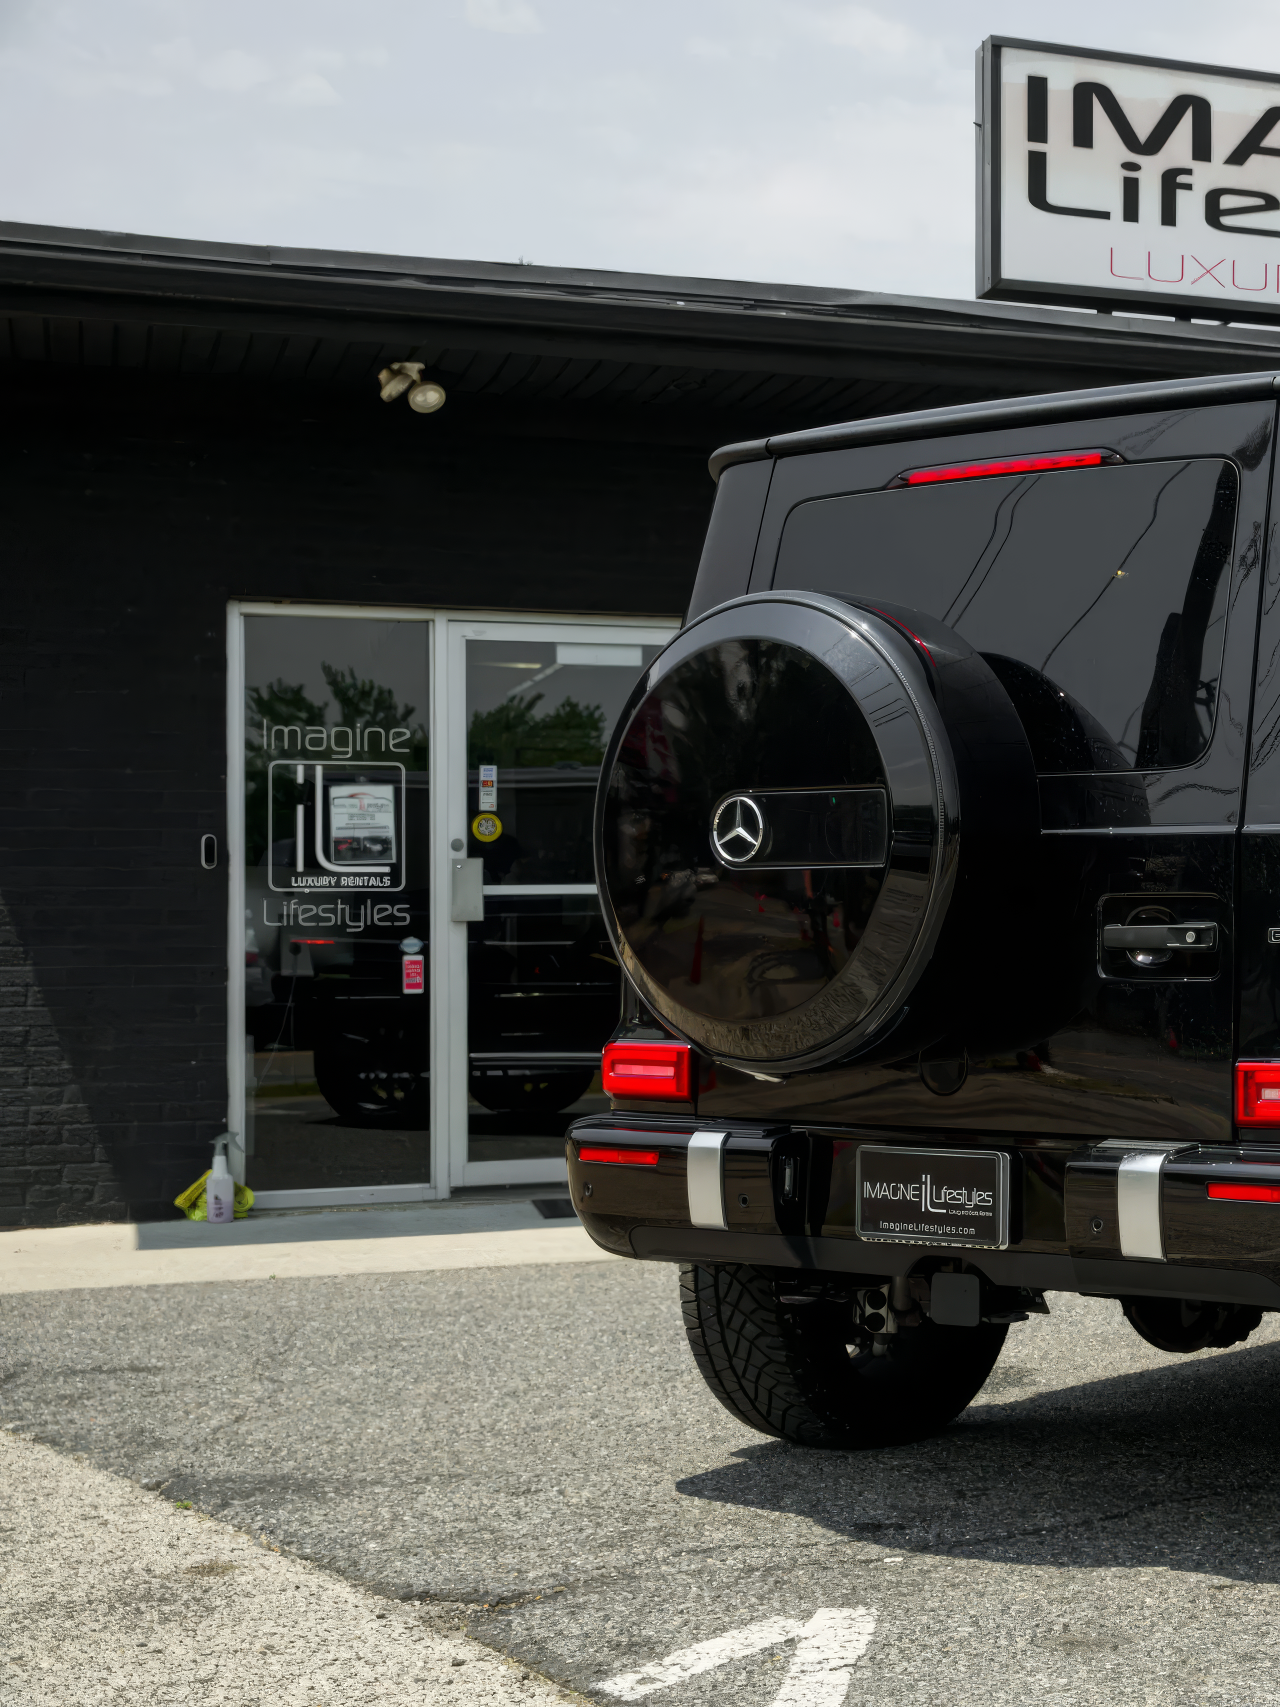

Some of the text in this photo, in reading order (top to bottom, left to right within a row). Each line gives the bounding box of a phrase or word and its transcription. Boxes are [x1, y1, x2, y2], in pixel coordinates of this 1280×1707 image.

[263, 718, 411, 759] Imagine
[292, 876, 391, 887] LUXURY RENTALS
[263, 898, 411, 933] Lifestyles
[932, 1184, 993, 1208] Lifestyles
